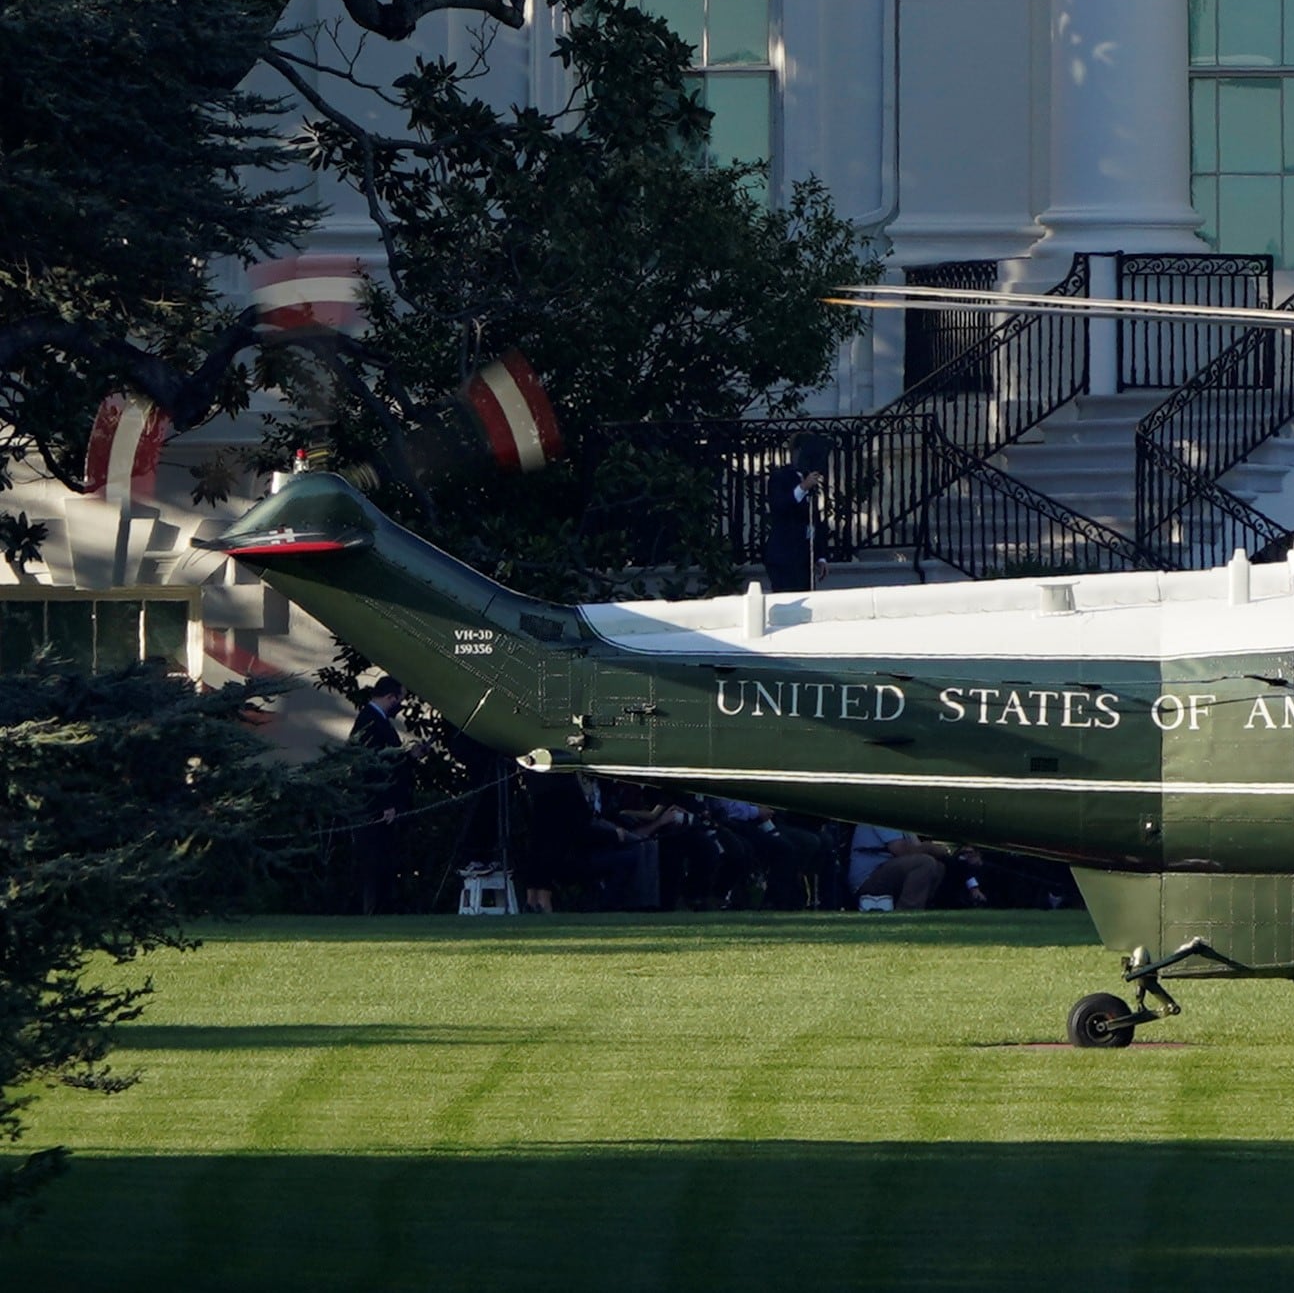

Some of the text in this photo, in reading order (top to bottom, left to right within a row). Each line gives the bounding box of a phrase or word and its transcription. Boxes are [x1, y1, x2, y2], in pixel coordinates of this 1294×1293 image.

[454, 629, 493, 640] VH-3D
[454, 644, 493, 655] 159356
[714, 679, 906, 722] UNITED
[938, 687, 1121, 729] STATES
[1151, 693, 1217, 731] OF
